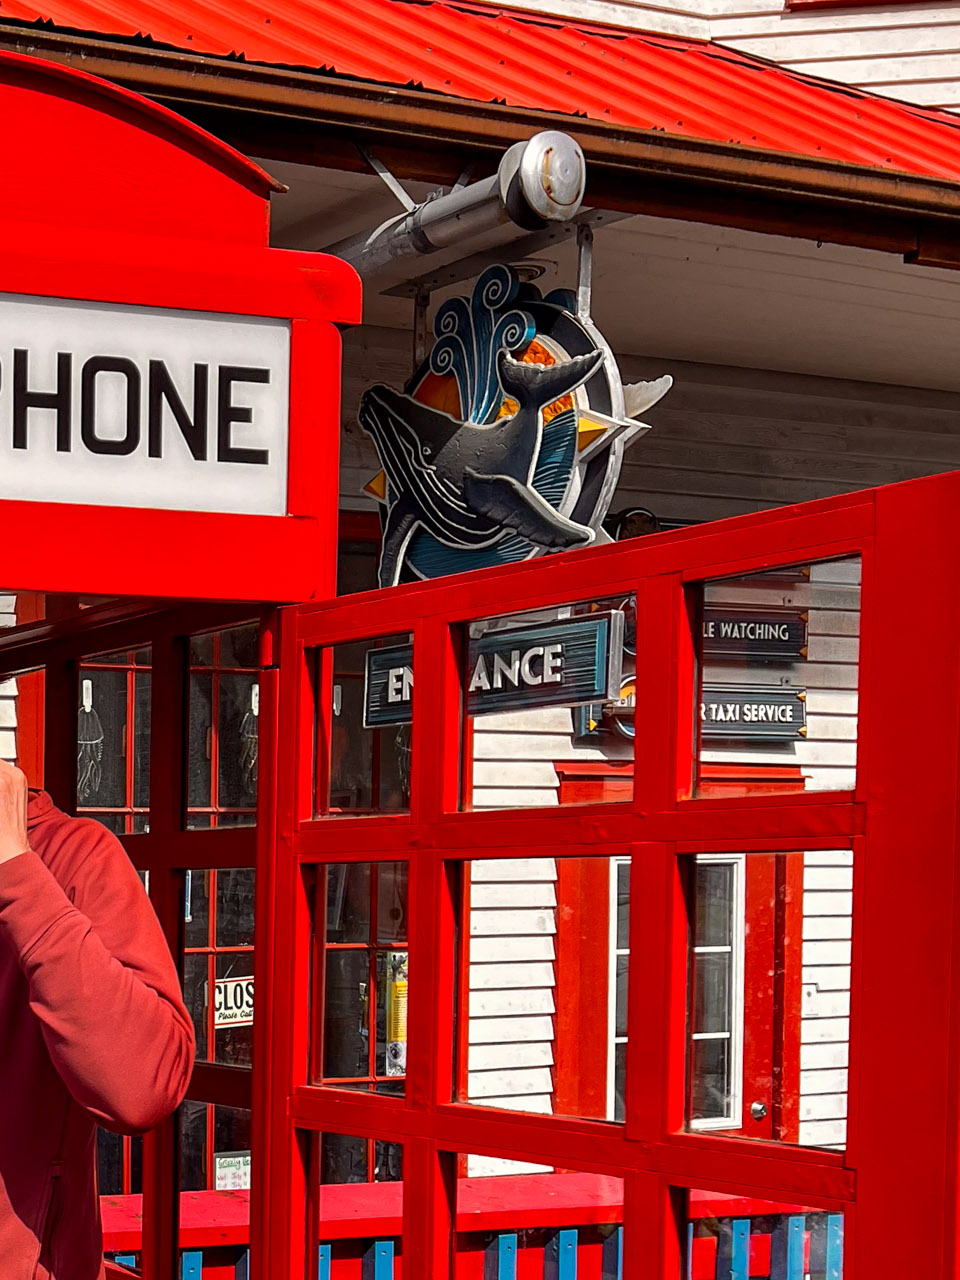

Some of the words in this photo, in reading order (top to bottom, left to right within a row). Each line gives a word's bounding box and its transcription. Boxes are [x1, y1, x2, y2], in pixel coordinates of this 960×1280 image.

[720, 622, 789, 640] WATCHING
[388, 644, 563, 703] ENANCE
[711, 703, 739, 721] TAXI
[743, 704, 793, 722] SERVICE
[215, 981, 254, 1012] CLOS
[218, 1011, 238, 1020] Please
